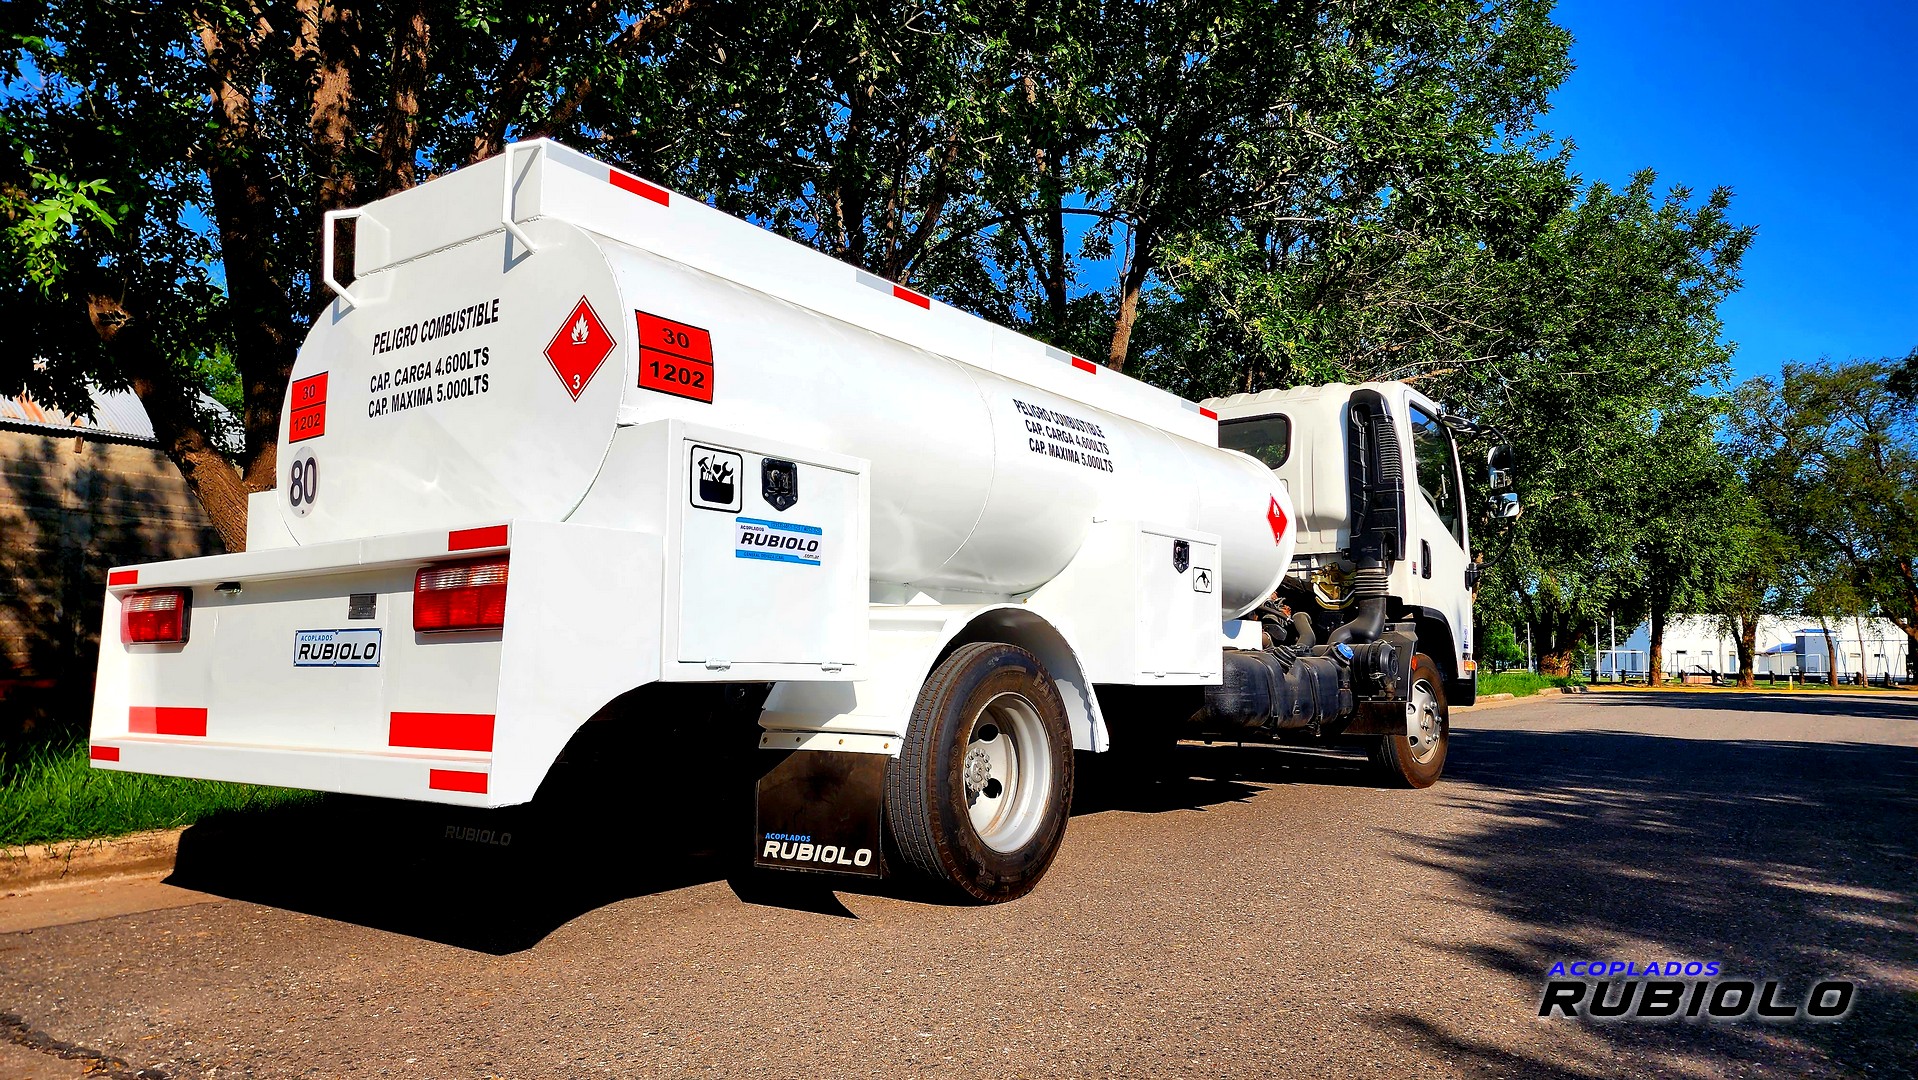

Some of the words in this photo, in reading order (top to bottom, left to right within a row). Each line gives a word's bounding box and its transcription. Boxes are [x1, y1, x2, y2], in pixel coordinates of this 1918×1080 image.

[372, 323, 419, 355] PELIGRO
[420, 298, 500, 343] COMBUSTIBLE
[662, 327, 690, 349] 30
[370, 371, 391, 393] CAP.
[394, 361, 432, 387] CARGA
[434, 346, 490, 377] 4.600LTS
[572, 374, 581, 390] 3
[649, 360, 705, 389] 1202
[302, 384, 316, 400] 30
[368, 397, 388, 418] CAP.
[391, 386, 433, 413] MAXIMA
[436, 373, 489, 403] 5.000LTS
[293, 412, 321, 432] 1202
[1012, 398, 1052, 423] PELIGRO
[1049, 410, 1106, 439] COMBUSTIBLE
[1025, 419, 1045, 437] CAP.
[1045, 425, 1075, 446] CARGA
[1075, 434, 1110, 455] 4.600LTS
[1028, 437, 1047, 455] CAP.
[1047, 442, 1081, 465] MAXIMA
[1080, 452, 1114, 473] 5.000LTS
[289, 456, 317, 508] 80
[740, 532, 819, 552] RUBIOLO
[297, 642, 377, 660] RUBIOLO
[444, 825, 512, 845] RUBIOLO
[765, 832, 811, 843] ACOPLADOS
[762, 840, 872, 867] RUBIOLO
